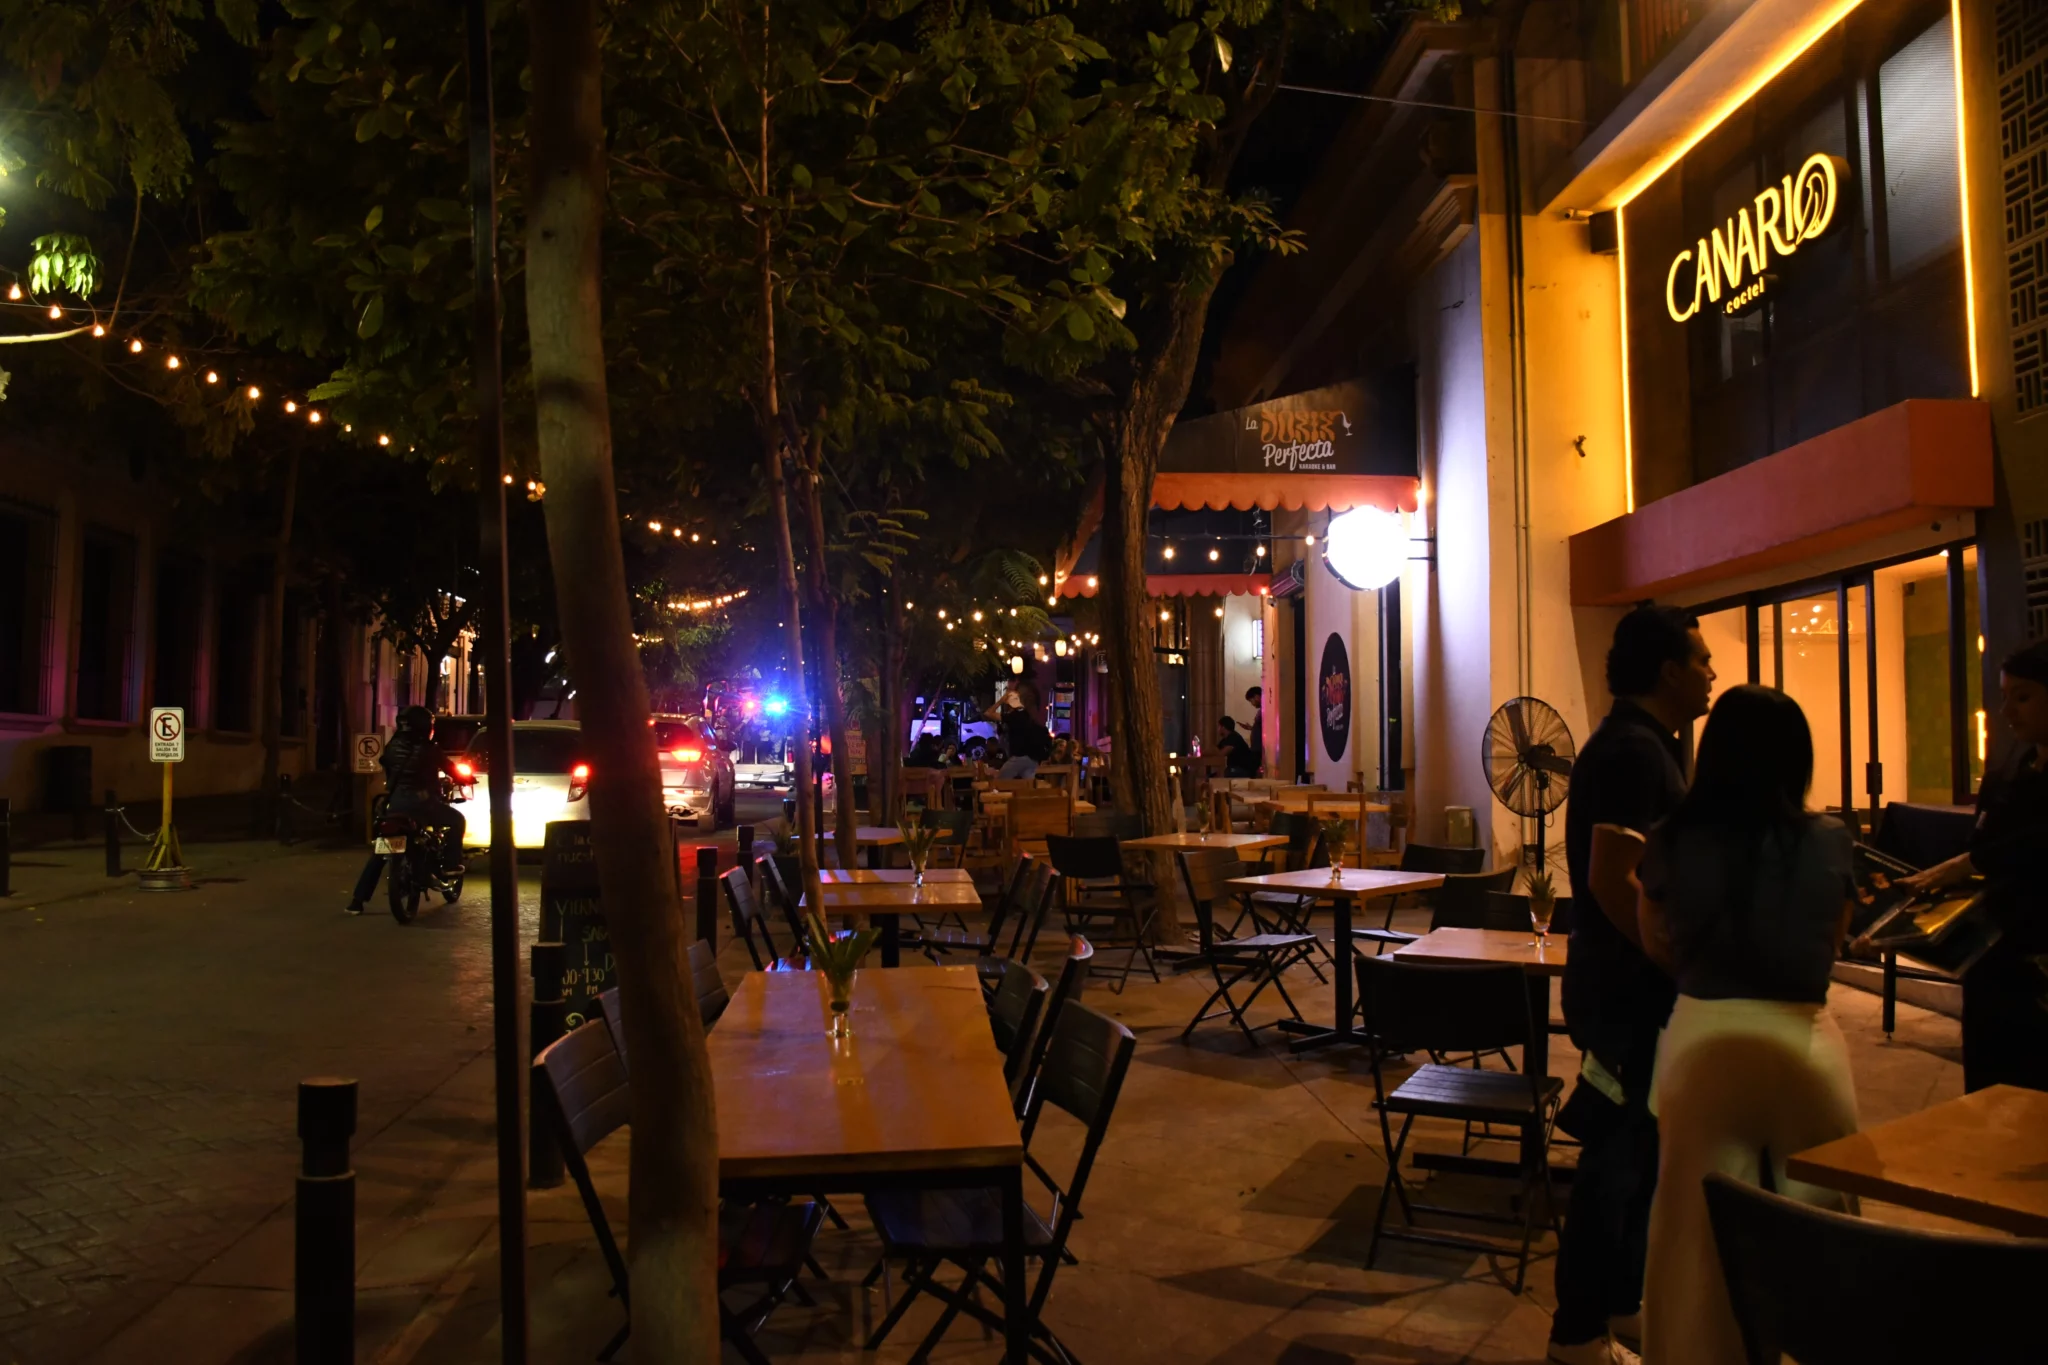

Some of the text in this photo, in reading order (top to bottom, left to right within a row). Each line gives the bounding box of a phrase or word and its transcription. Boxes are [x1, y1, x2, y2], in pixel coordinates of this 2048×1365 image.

[1666, 153, 1837, 322] CANARIO
[1726, 276, 1765, 314] coctel
[1245, 416, 1258, 431] La
[1262, 440, 1334, 471] Perfecta
